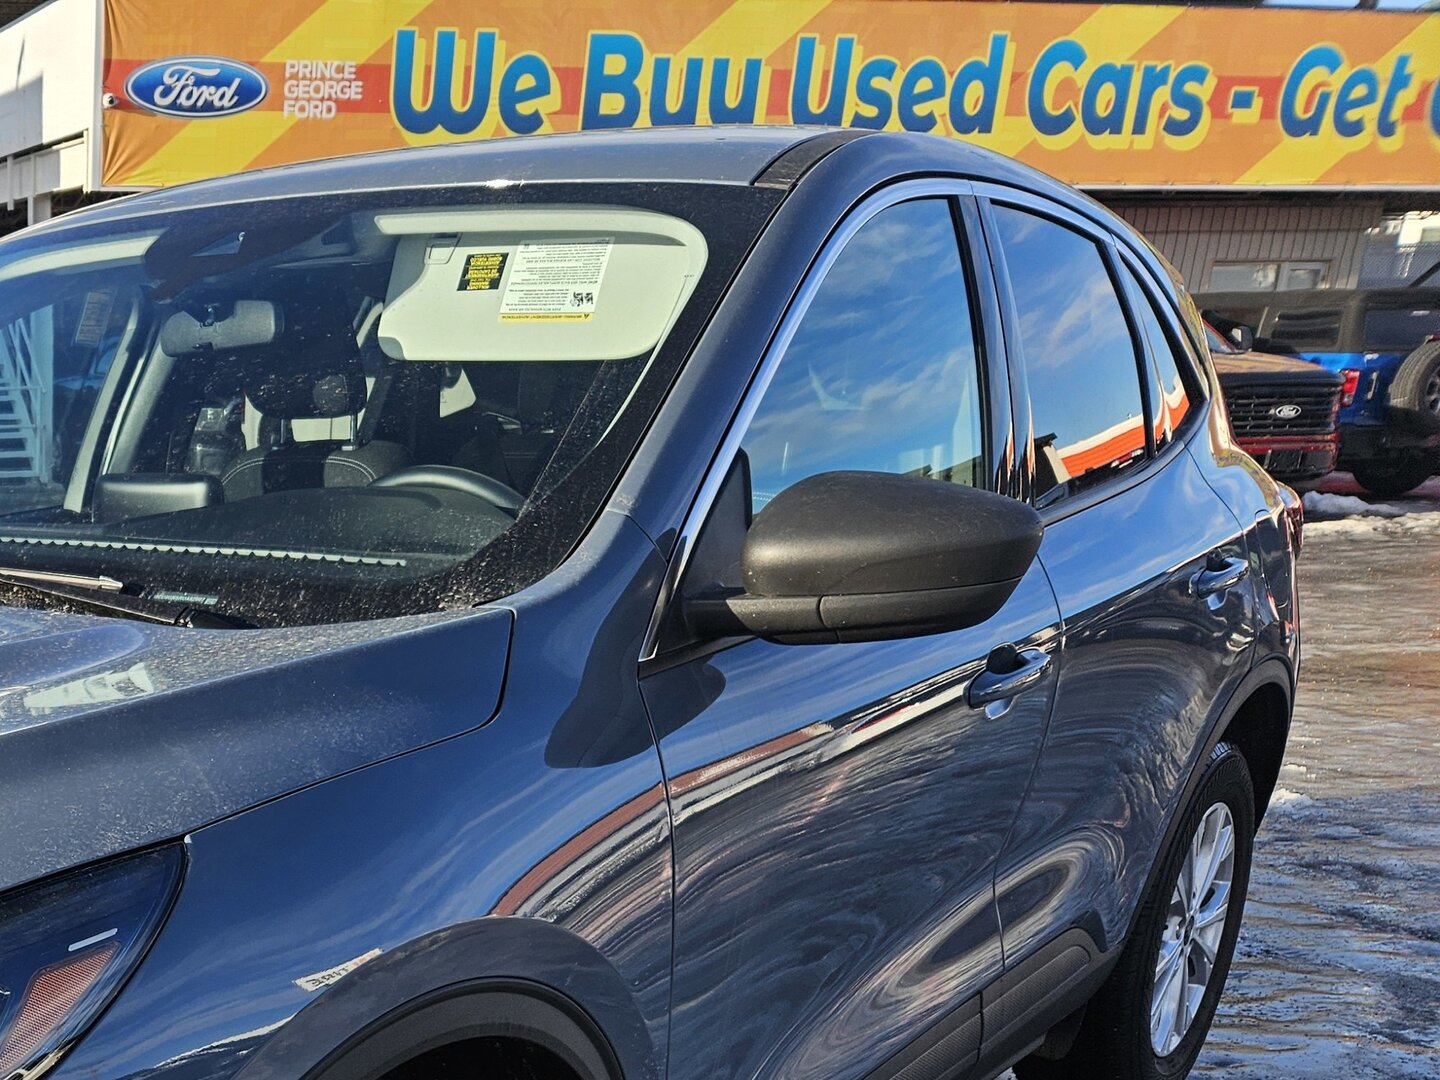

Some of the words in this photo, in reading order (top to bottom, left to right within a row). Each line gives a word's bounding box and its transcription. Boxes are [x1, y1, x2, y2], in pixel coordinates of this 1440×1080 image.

[285, 60, 357, 79] PRINCE
[153, 64, 242, 110] Ford
[283, 80, 363, 100] GEORGE
[393, 29, 551, 135] We
[790, 32, 1010, 134] Used
[1027, 38, 1211, 137] Cars
[1279, 45, 1413, 138] Get
[283, 100, 337, 119] FORD
